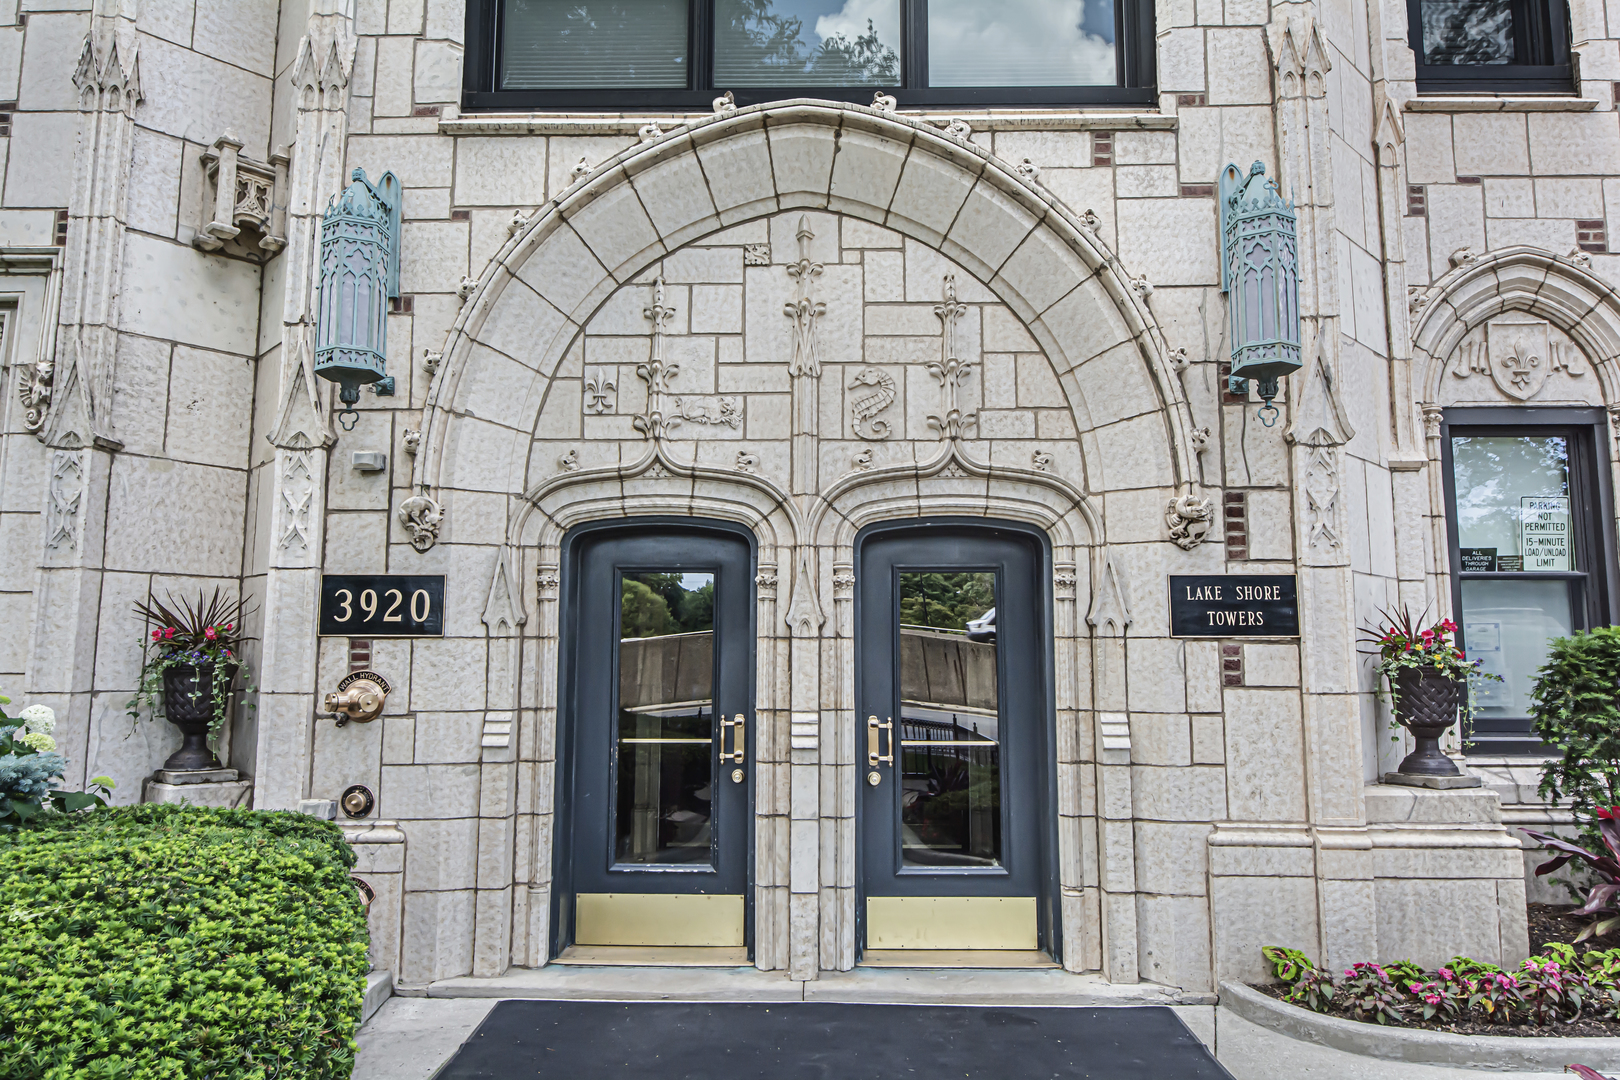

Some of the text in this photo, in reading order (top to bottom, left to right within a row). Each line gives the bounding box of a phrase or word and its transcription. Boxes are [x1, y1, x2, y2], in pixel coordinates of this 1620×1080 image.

[1537, 512, 1552, 520] NOT
[1525, 522, 1566, 531] PERMITTED
[1526, 537, 1565, 546] 15-MINUTE
[1525, 547, 1566, 557] LOAD/UNLOAD
[1536, 558, 1555, 567] LIMIT
[1186, 585, 1281, 601] LAKE SHORE
[333, 588, 430, 622] 3920
[1206, 610, 1264, 626] TOWERS
[339, 672, 390, 692] WALL HYDRANT
